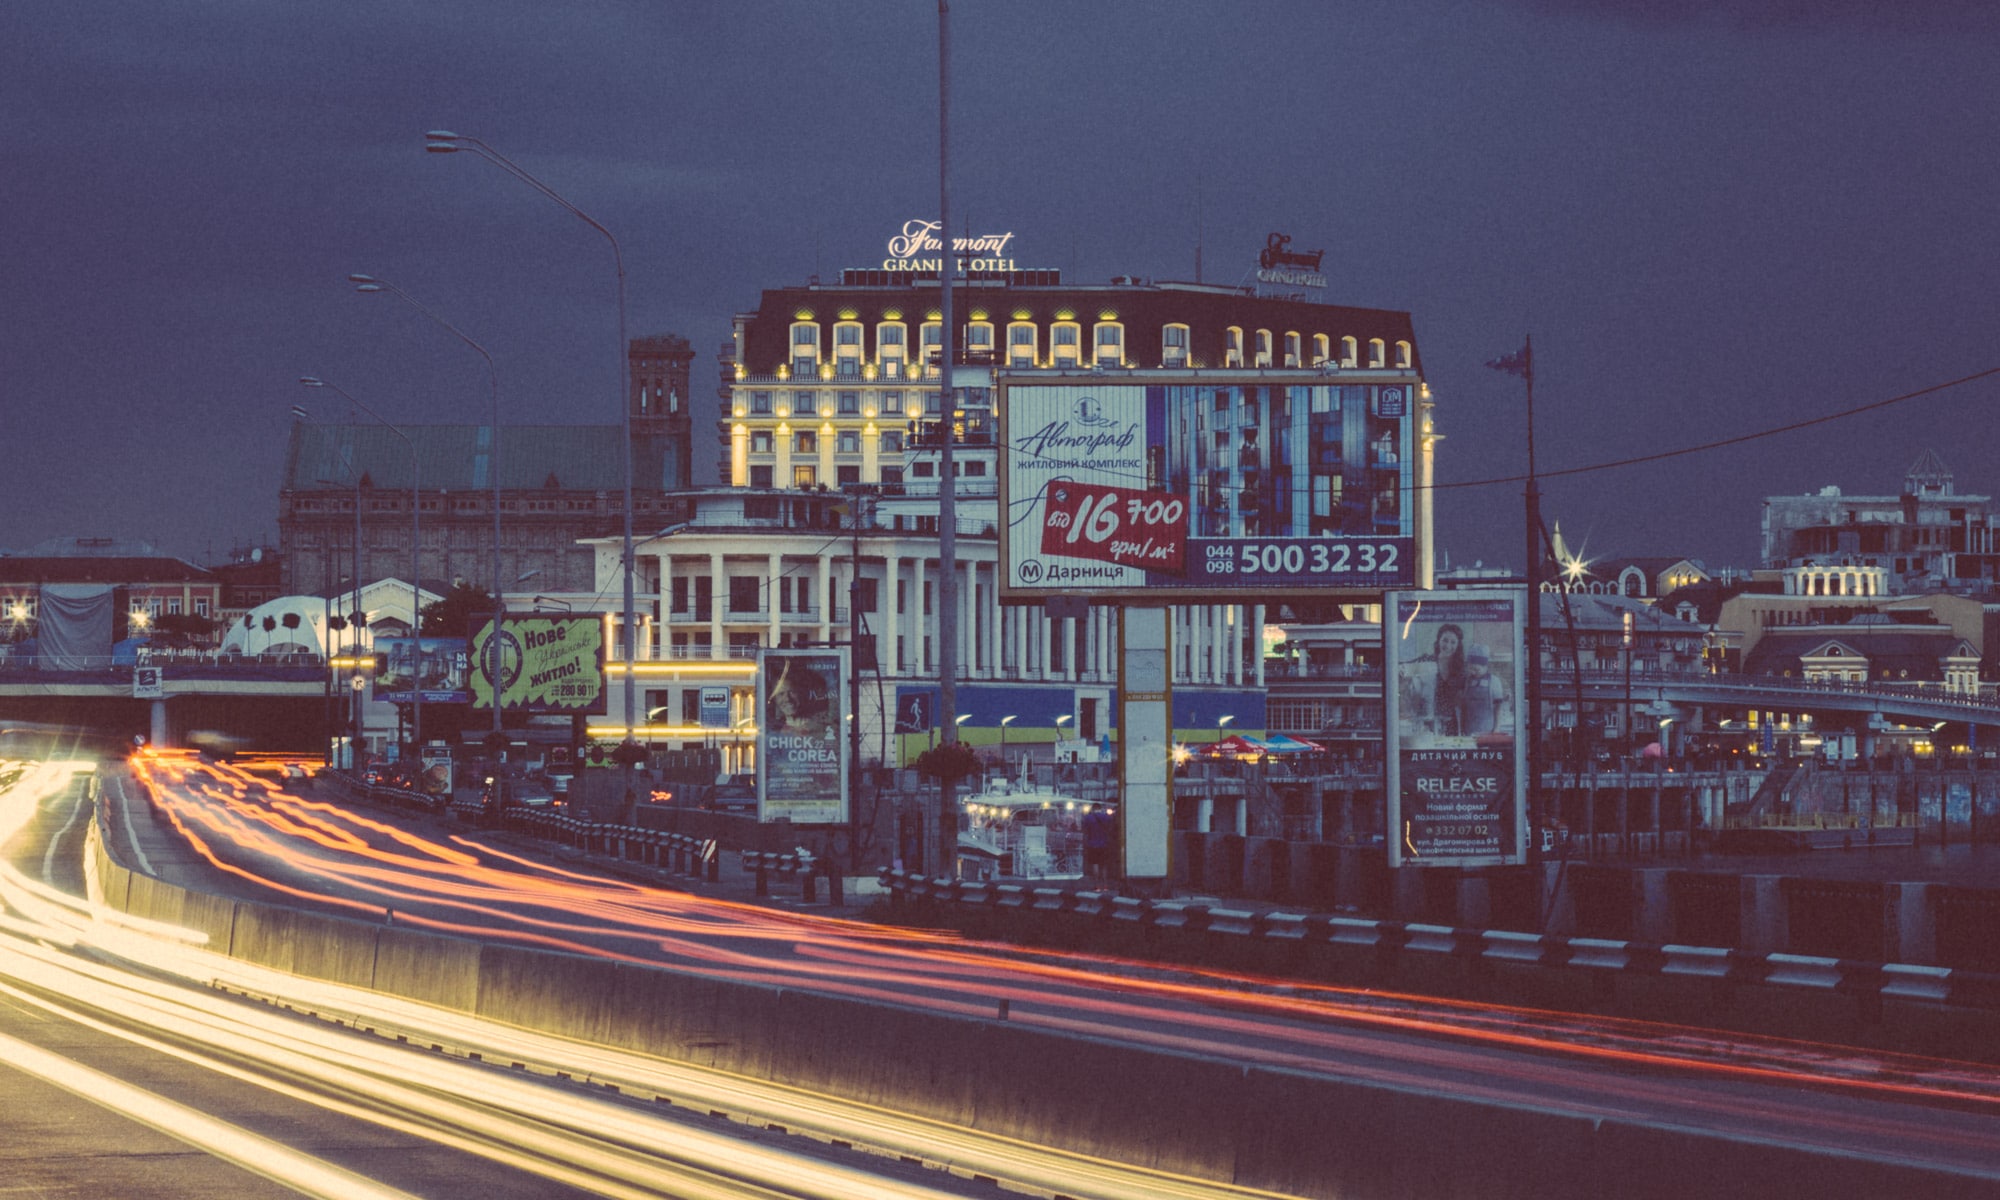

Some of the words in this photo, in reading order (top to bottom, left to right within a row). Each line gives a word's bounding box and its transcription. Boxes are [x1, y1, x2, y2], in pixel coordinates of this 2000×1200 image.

[888, 219, 1015, 258] Famont
[1016, 421, 1140, 458] Автограф
[1017, 458, 1079, 470] ЖИТЛОВИЙ
[1081, 459, 1141, 469] КОМПЛЕКС
[1047, 511, 1070, 528] від
[1066, 493, 1120, 543] 16
[1127, 499, 1183, 526] 700
[1206, 545, 1234, 558] 044
[1240, 544, 1305, 573] 500
[1310, 544, 1351, 573] 32
[1357, 544, 1399, 573] 32
[1047, 565, 1124, 581] Дарниця
[1206, 560, 1234, 573] 098
[524, 626, 566, 650] Нове
[530, 656, 580, 688] житло!
[560, 684, 575, 696] 280
[577, 684, 587, 696] 90
[588, 685, 594, 696] 11
[769, 736, 813, 749] CHICK
[788, 749, 837, 762] COREA
[1411, 750, 1467, 761] ДИТЯЧИЙ
[1472, 751, 1503, 760] КЛУБ
[1416, 777, 1498, 793] RELEASE
[1426, 802, 1454, 812] Новий
[1455, 803, 1488, 814] формат
[1415, 812, 1472, 821] позашкільної
[1435, 825, 1456, 835] 332
[1458, 825, 1472, 835] 07
[1474, 825, 1488, 835] 02
